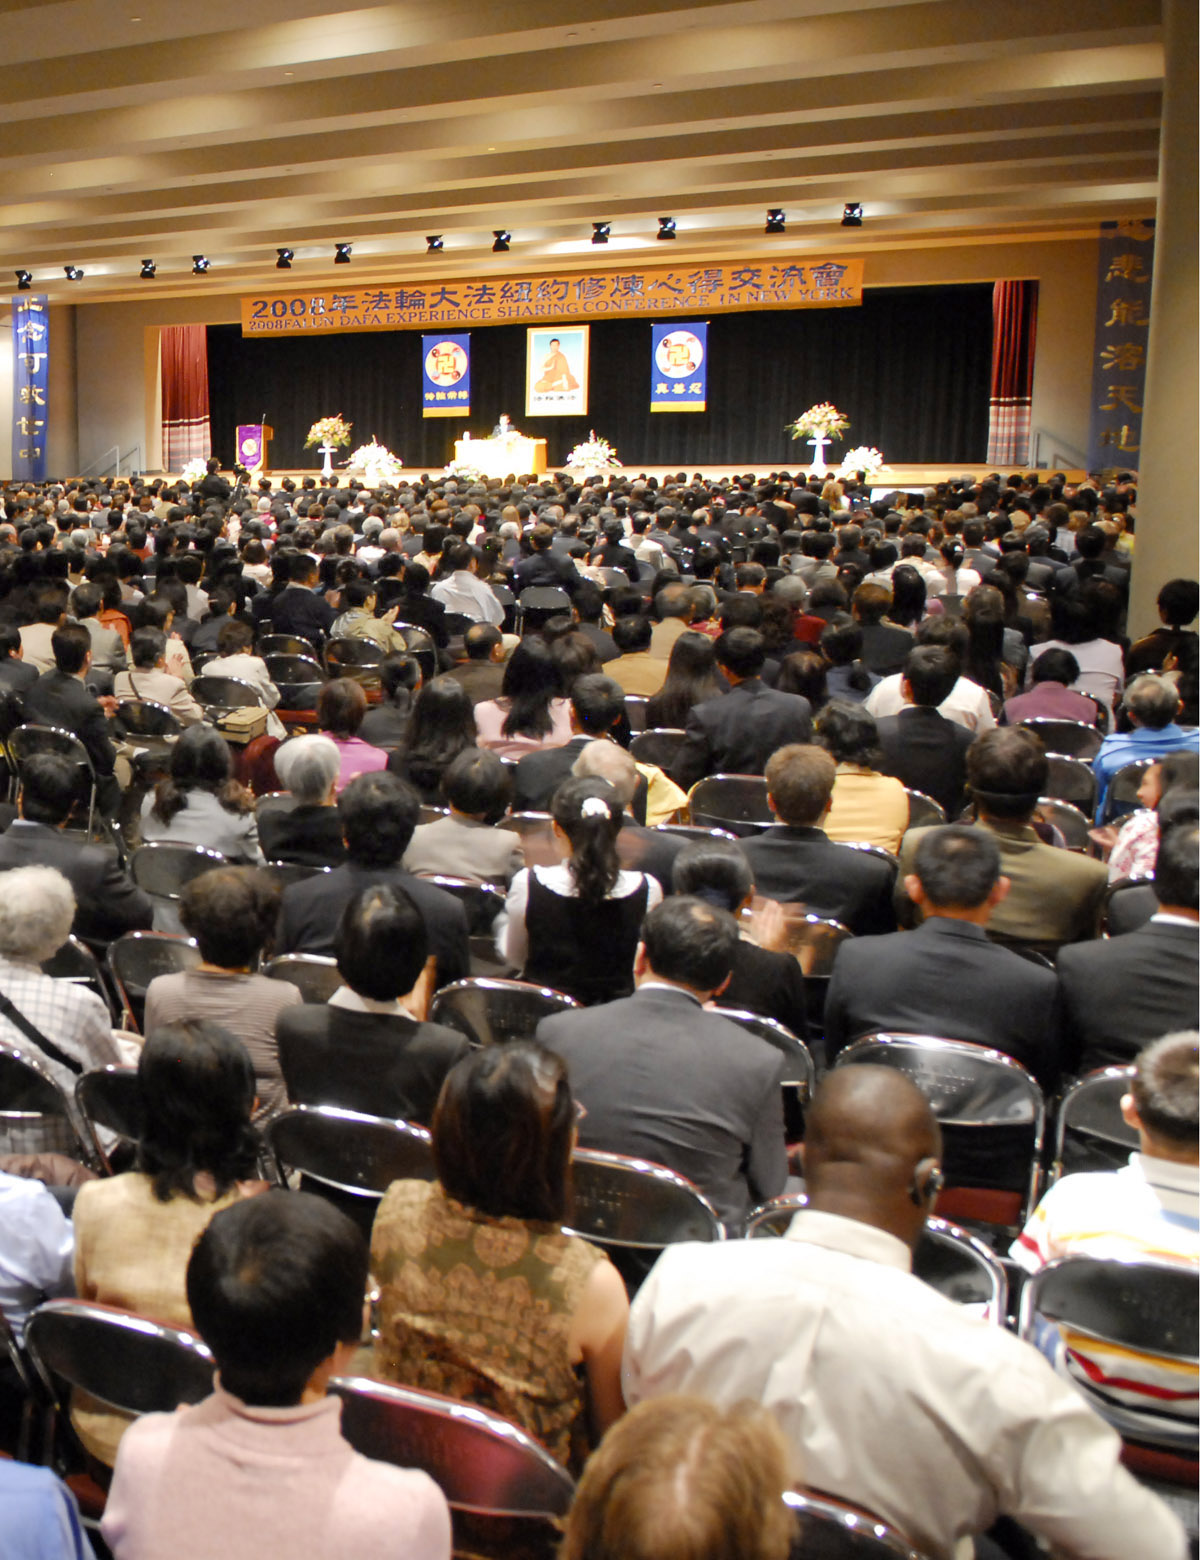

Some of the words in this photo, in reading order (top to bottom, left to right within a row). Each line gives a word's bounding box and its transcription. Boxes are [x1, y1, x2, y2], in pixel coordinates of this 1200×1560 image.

[249, 316, 334, 331] 2008FALUN
[340, 313, 382, 327] DAFA
[386, 308, 491, 324] EXPERIENCE
[497, 302, 579, 318] SHARING
[583, 295, 710, 313] CONFERENCE
[719, 293, 741, 305] IN
[746, 289, 793, 304] NEW
[798, 286, 854, 301] YORK
[252, 262, 848, 319] 2008年法輪大法紐約修煉心得交流會
[655, 382, 703, 395] 真善忍
